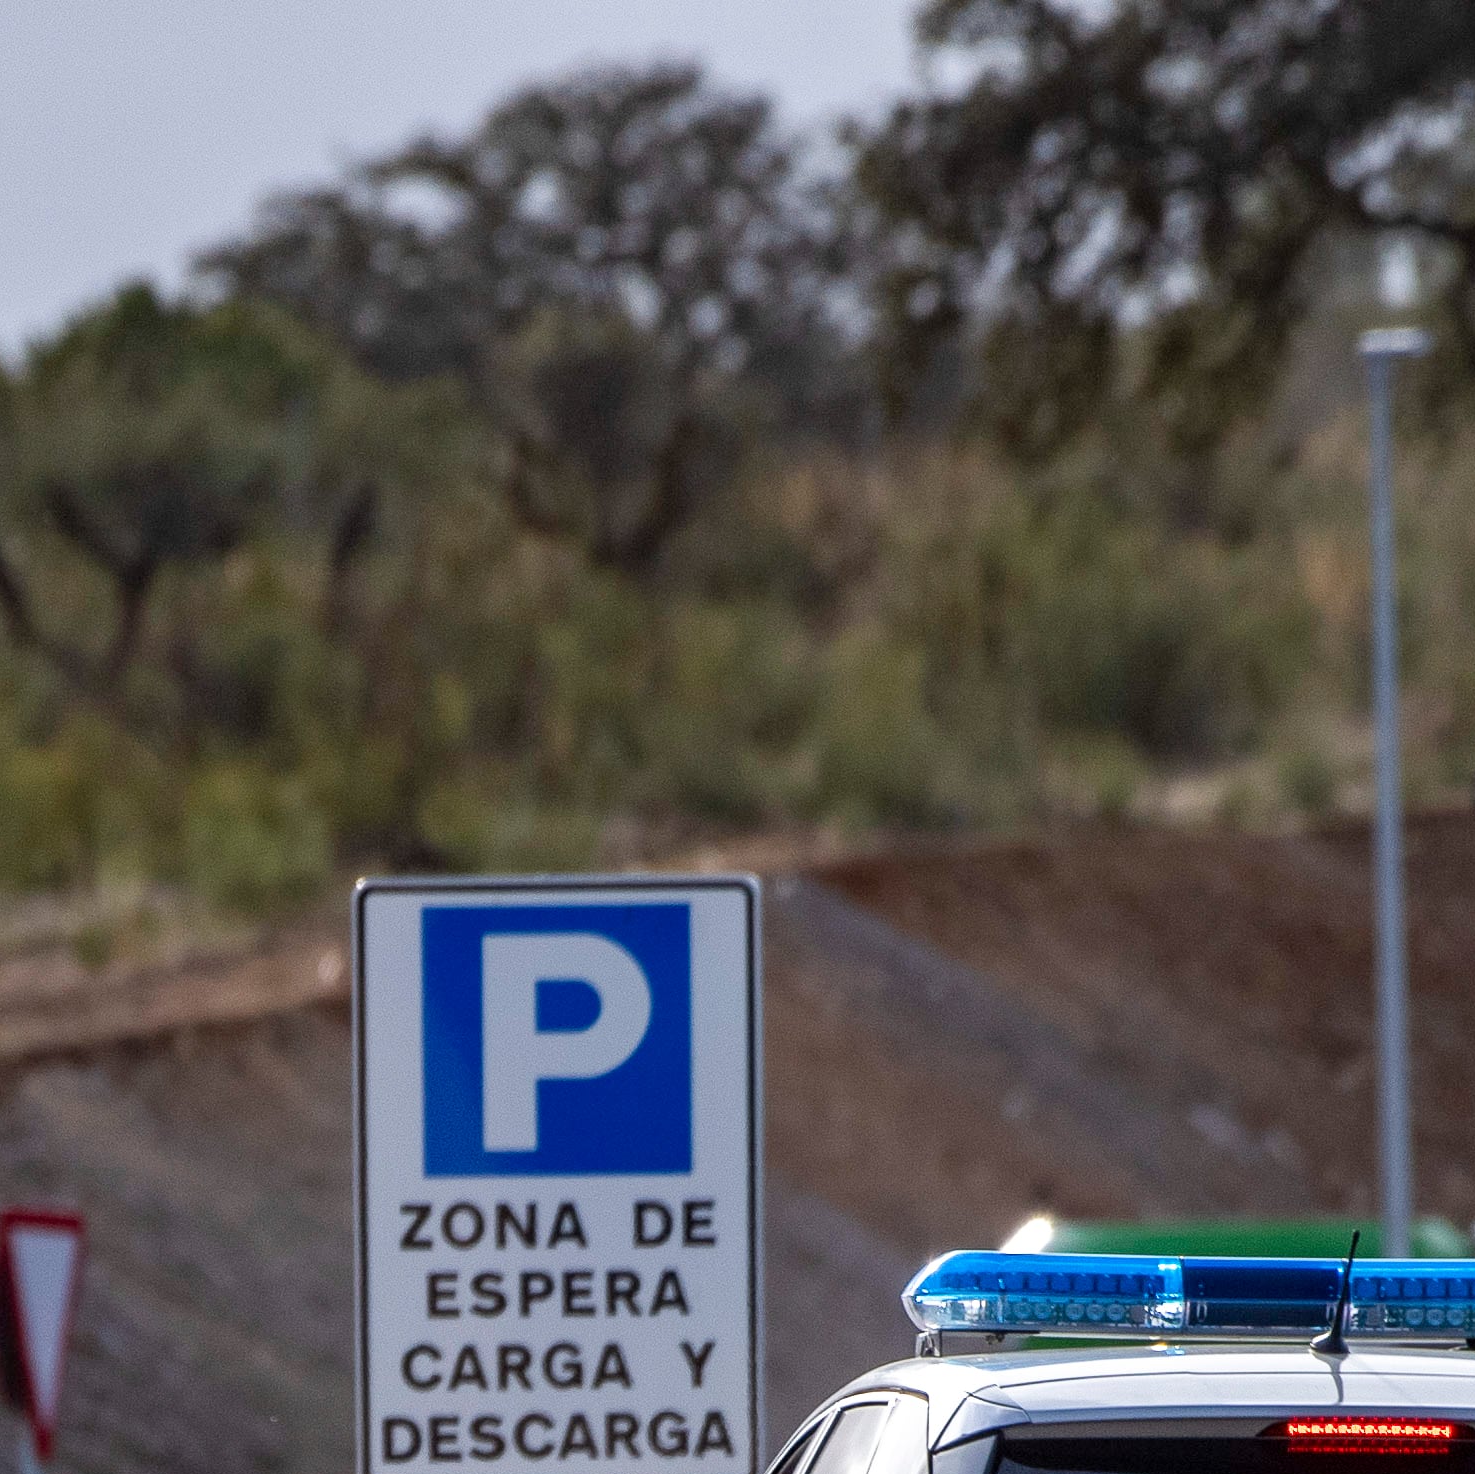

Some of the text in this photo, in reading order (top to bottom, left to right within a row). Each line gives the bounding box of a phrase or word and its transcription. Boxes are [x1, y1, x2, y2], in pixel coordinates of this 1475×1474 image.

[480, 931, 652, 1153] P
[399, 1199, 717, 1251] ZONA DE
[426, 1269, 689, 1319] ESPERA
[401, 1340, 716, 1391] CARGA Y
[382, 1411, 734, 1464] DESCARGA
